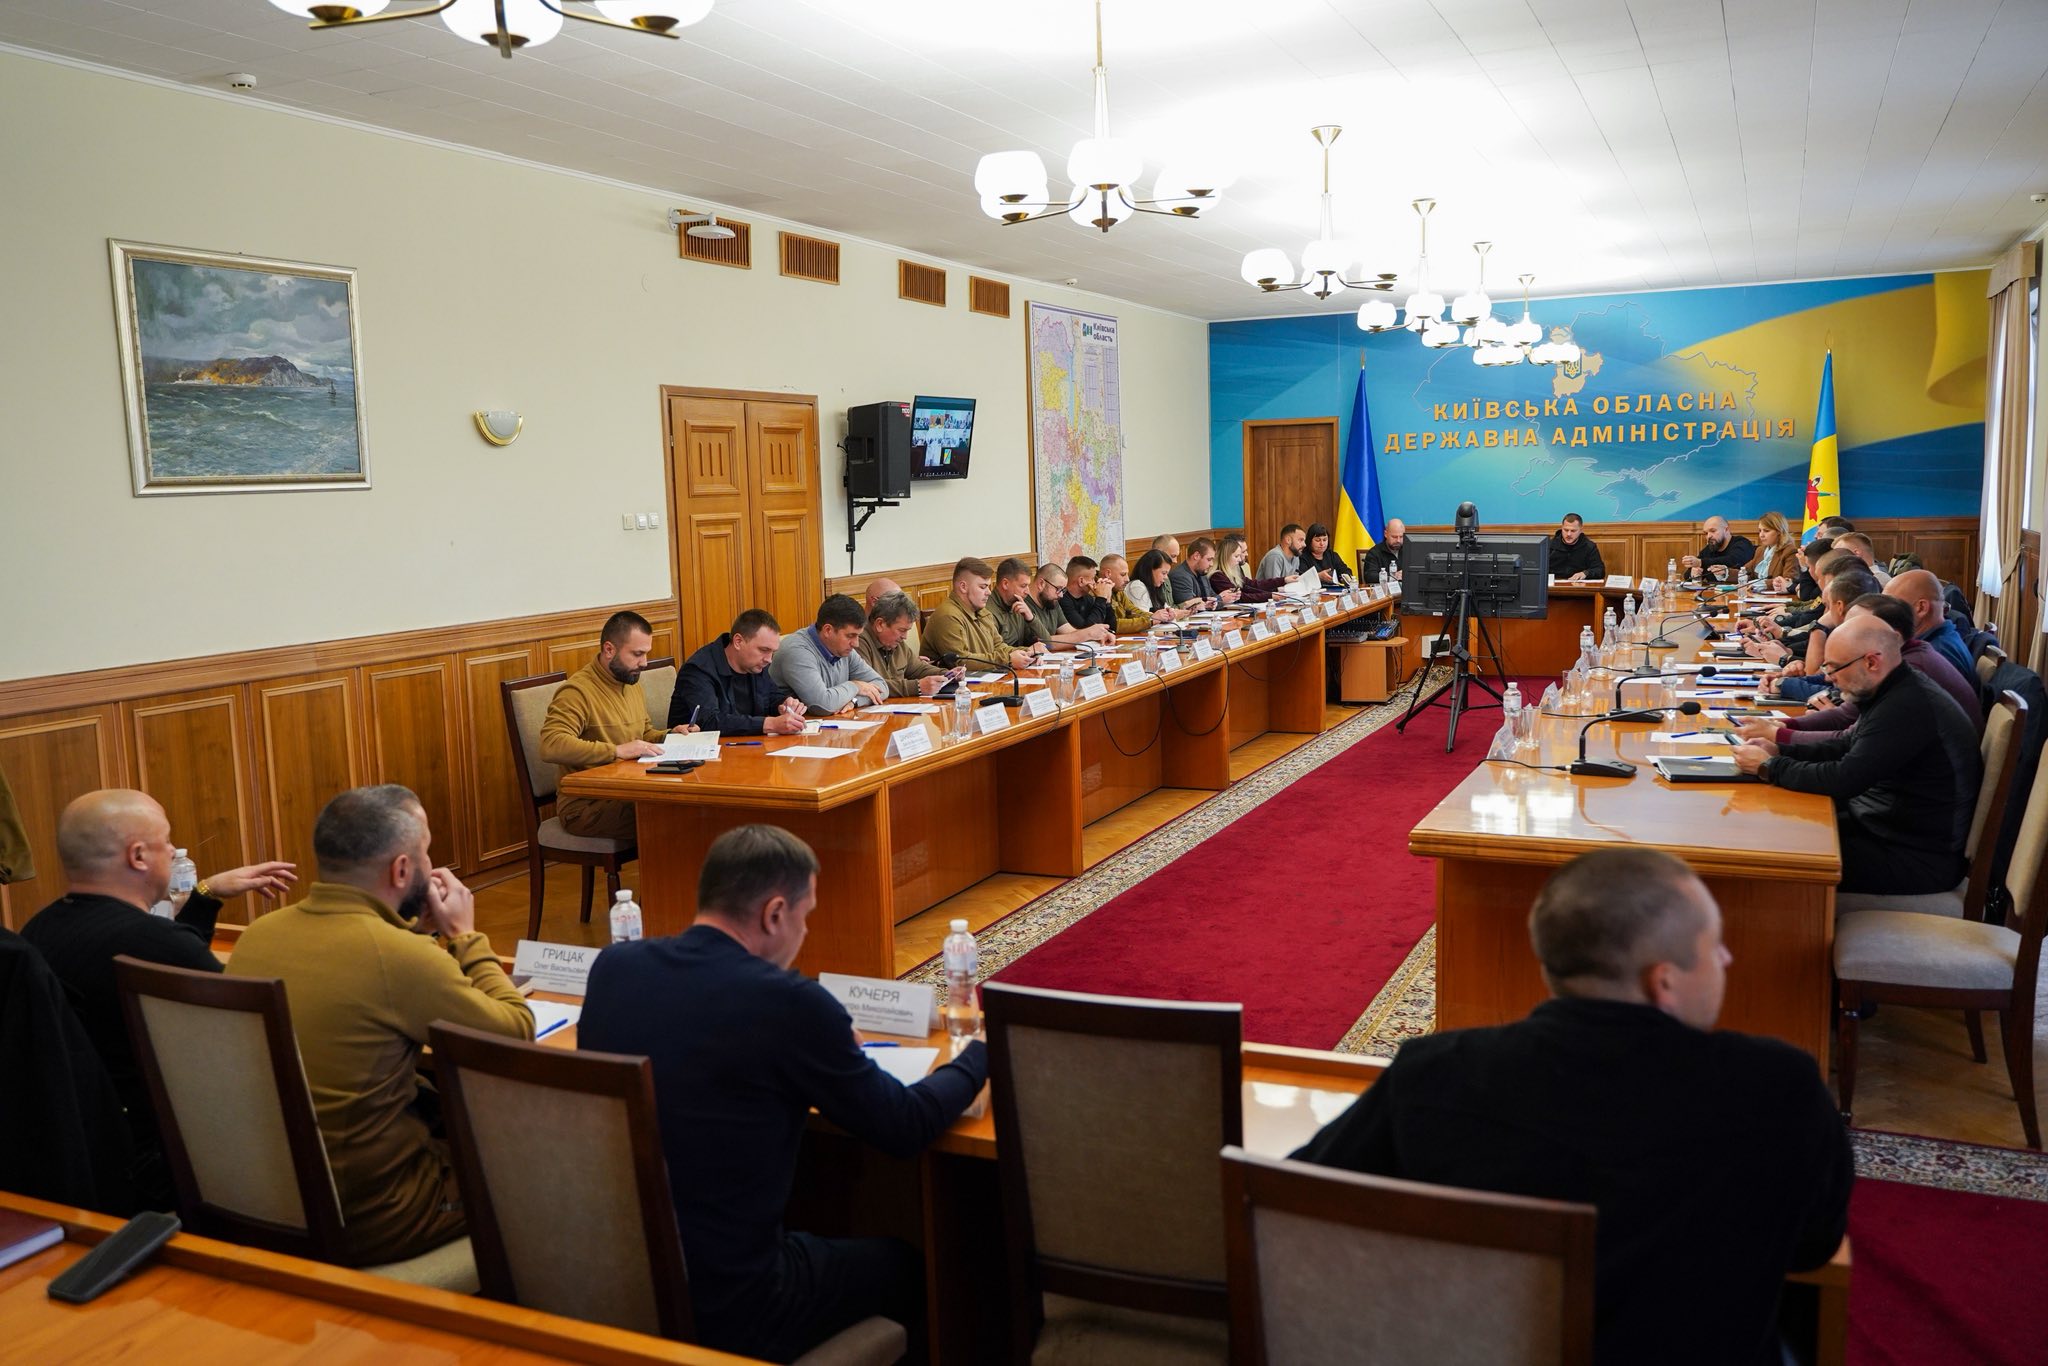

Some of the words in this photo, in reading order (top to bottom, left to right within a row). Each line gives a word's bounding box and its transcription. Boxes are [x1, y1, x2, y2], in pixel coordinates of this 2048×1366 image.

[1433, 397, 1579, 421] КИЇВСЬКА
[1593, 391, 1737, 415] ОБЛАСНА
[1384, 428, 1538, 454] ДЕРЖАВНА
[1551, 418, 1796, 447] АДМІНІСТРАЦІЯ
[543, 948, 584, 963] ГРИЦАК
[848, 986, 900, 1003] КУЧЕРЯ
